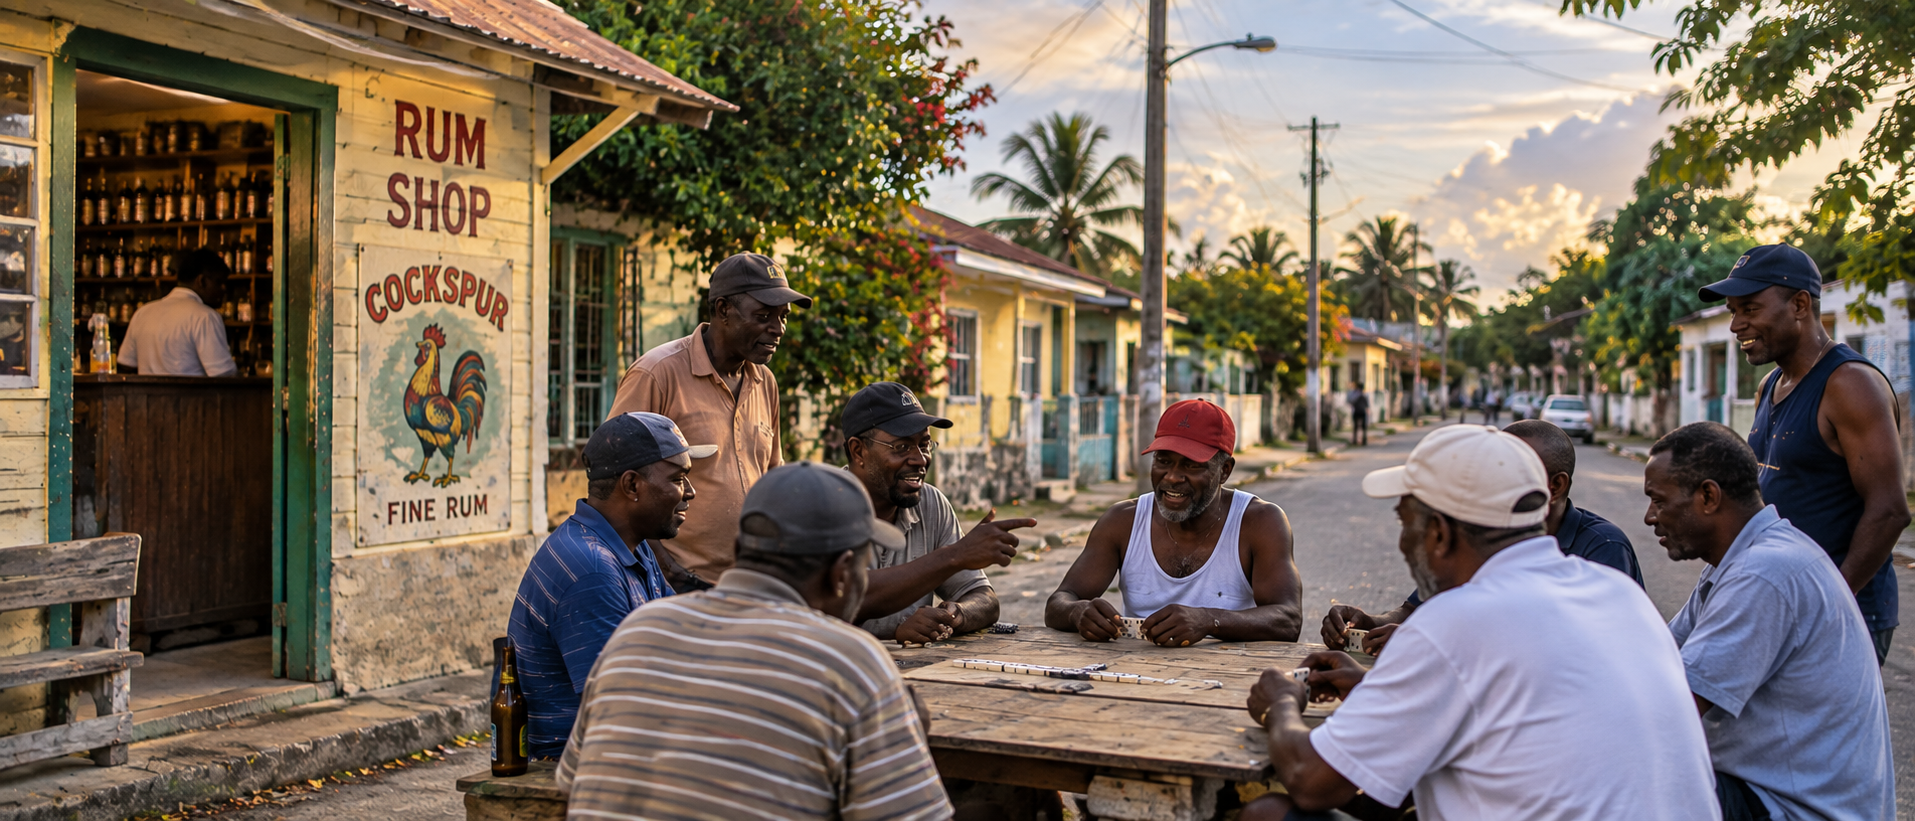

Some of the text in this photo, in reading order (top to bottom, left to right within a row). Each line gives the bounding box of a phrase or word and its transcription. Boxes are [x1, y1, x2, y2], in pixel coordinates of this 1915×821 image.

[394, 99, 486, 170] RUM
[387, 172, 491, 238] SHOP
[365, 265, 509, 332] COCKSPUR
[388, 494, 488, 525] FINE RUM
